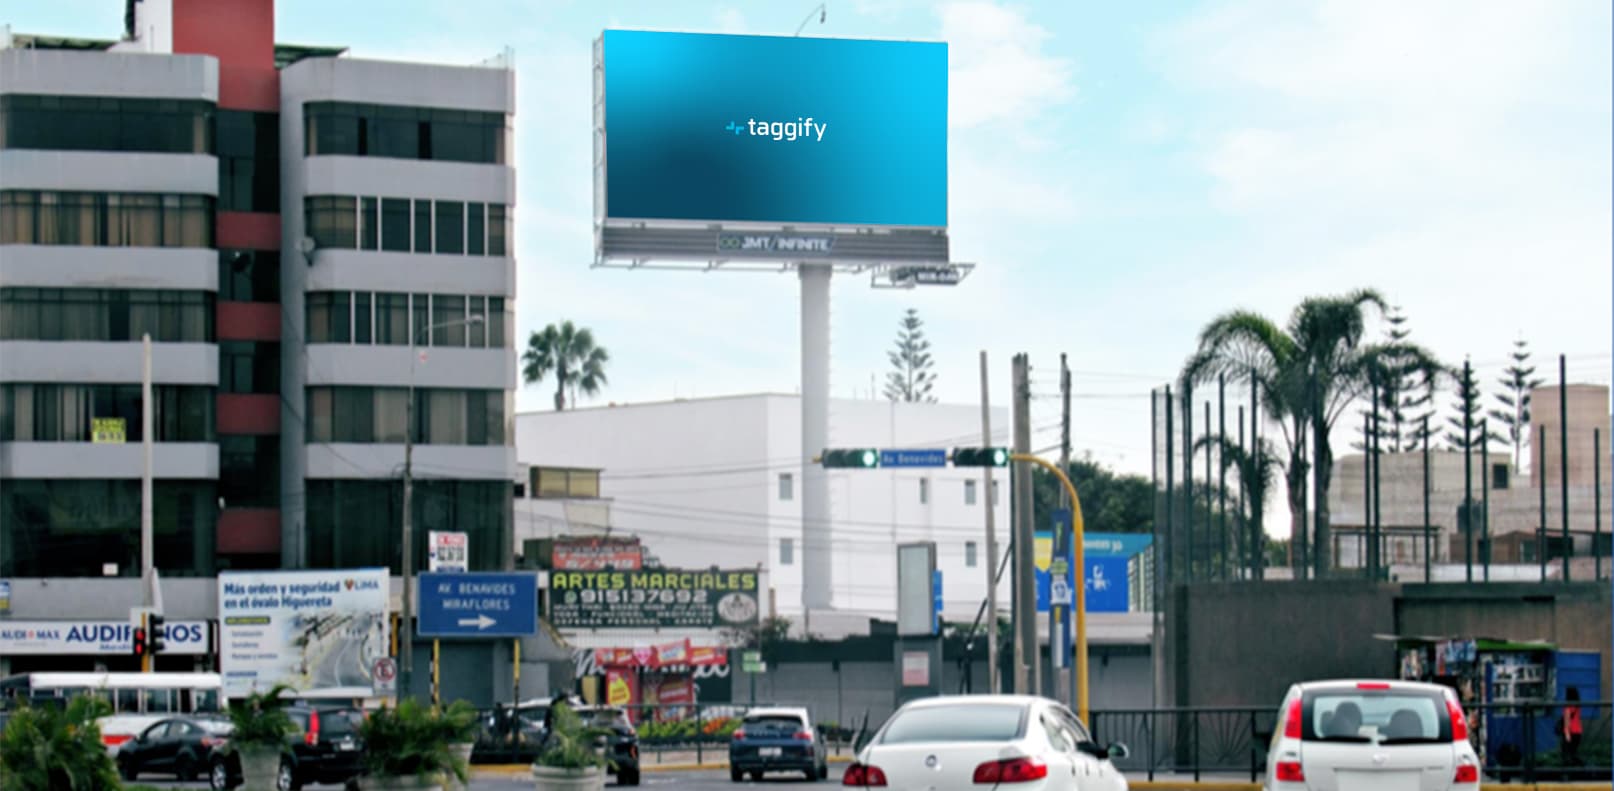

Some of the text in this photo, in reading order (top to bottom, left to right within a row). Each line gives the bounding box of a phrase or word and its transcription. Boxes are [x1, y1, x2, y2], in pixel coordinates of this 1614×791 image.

[747, 117, 827, 142] taggify
[248, 582, 277, 594] orden
[289, 581, 340, 596] seguridad
[552, 573, 756, 589] ARTES MARCIALES
[459, 583, 516, 595] BENAVIDES
[580, 589, 708, 604] 915137692
[442, 599, 511, 611] MIRAFLORES
